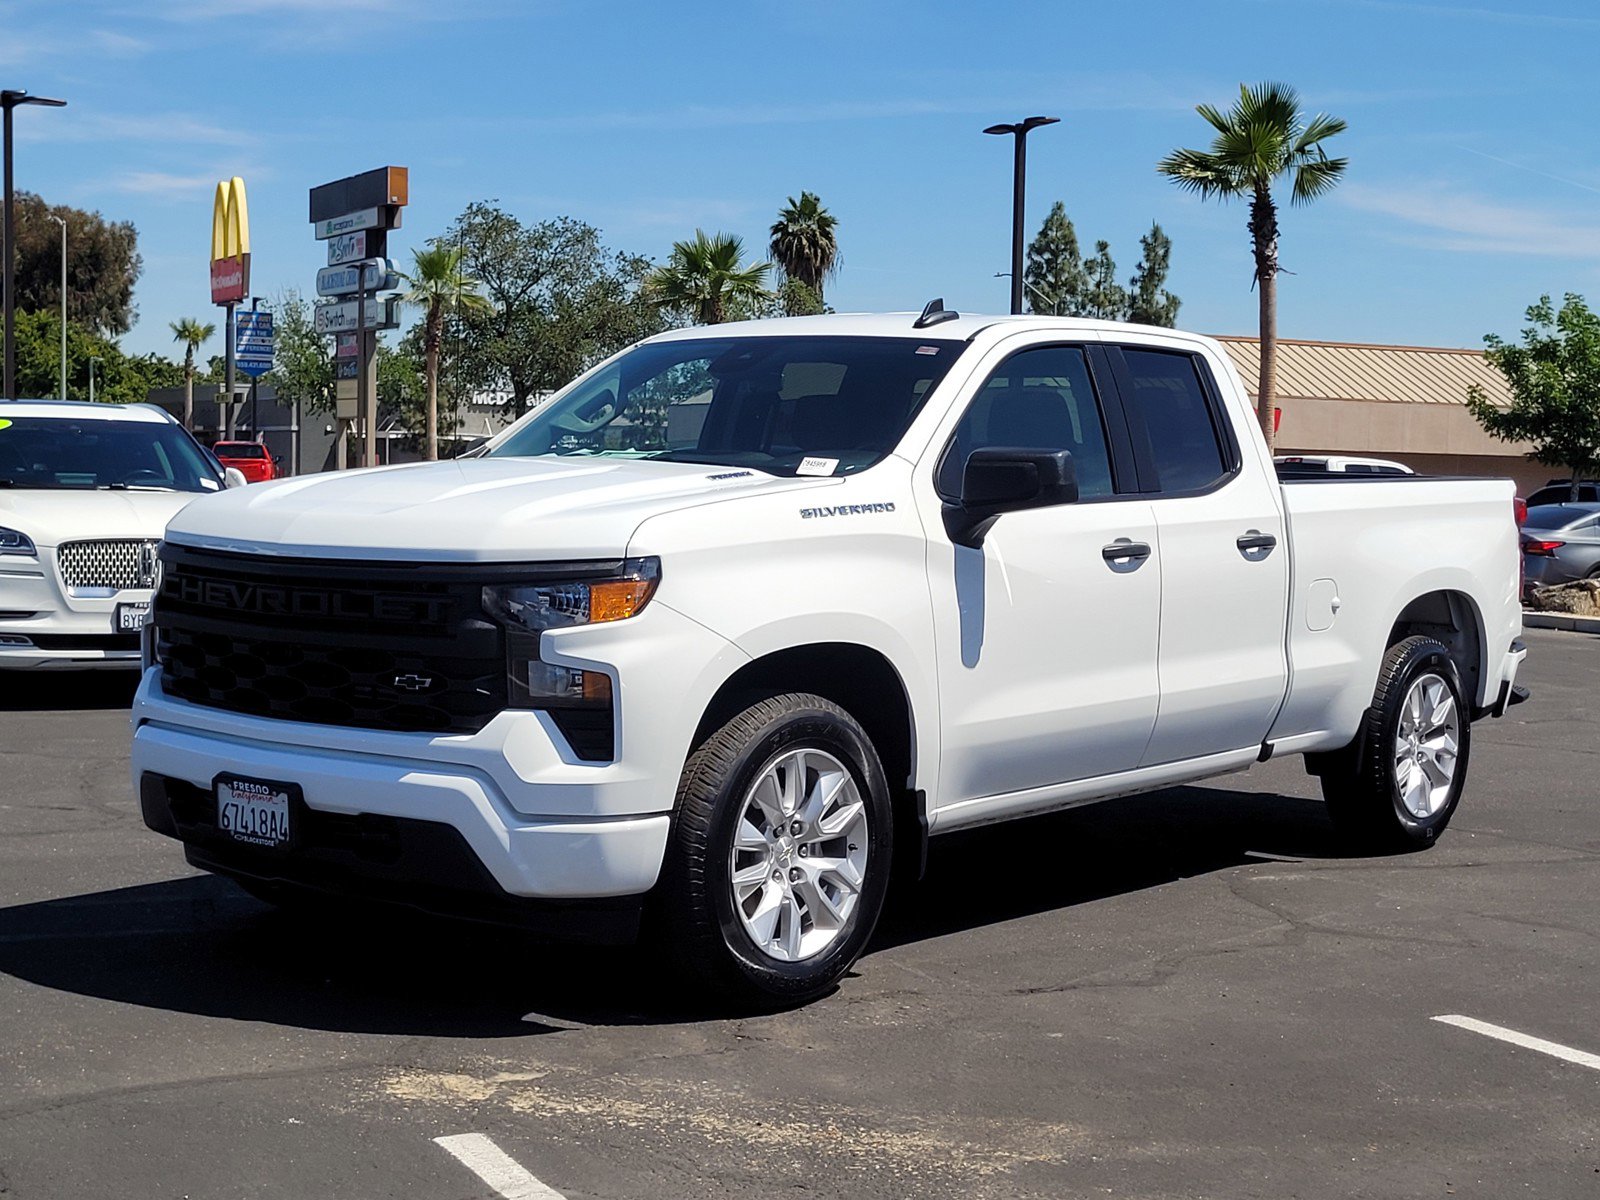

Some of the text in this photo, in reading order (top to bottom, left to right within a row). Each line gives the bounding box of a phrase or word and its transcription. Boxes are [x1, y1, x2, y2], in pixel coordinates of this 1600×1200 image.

[799, 502, 896, 518] SILVERADO
[161, 575, 455, 621] CHEVROLET
[233, 781, 269, 795] FRESNO
[221, 802, 288, 841] 67418A4
